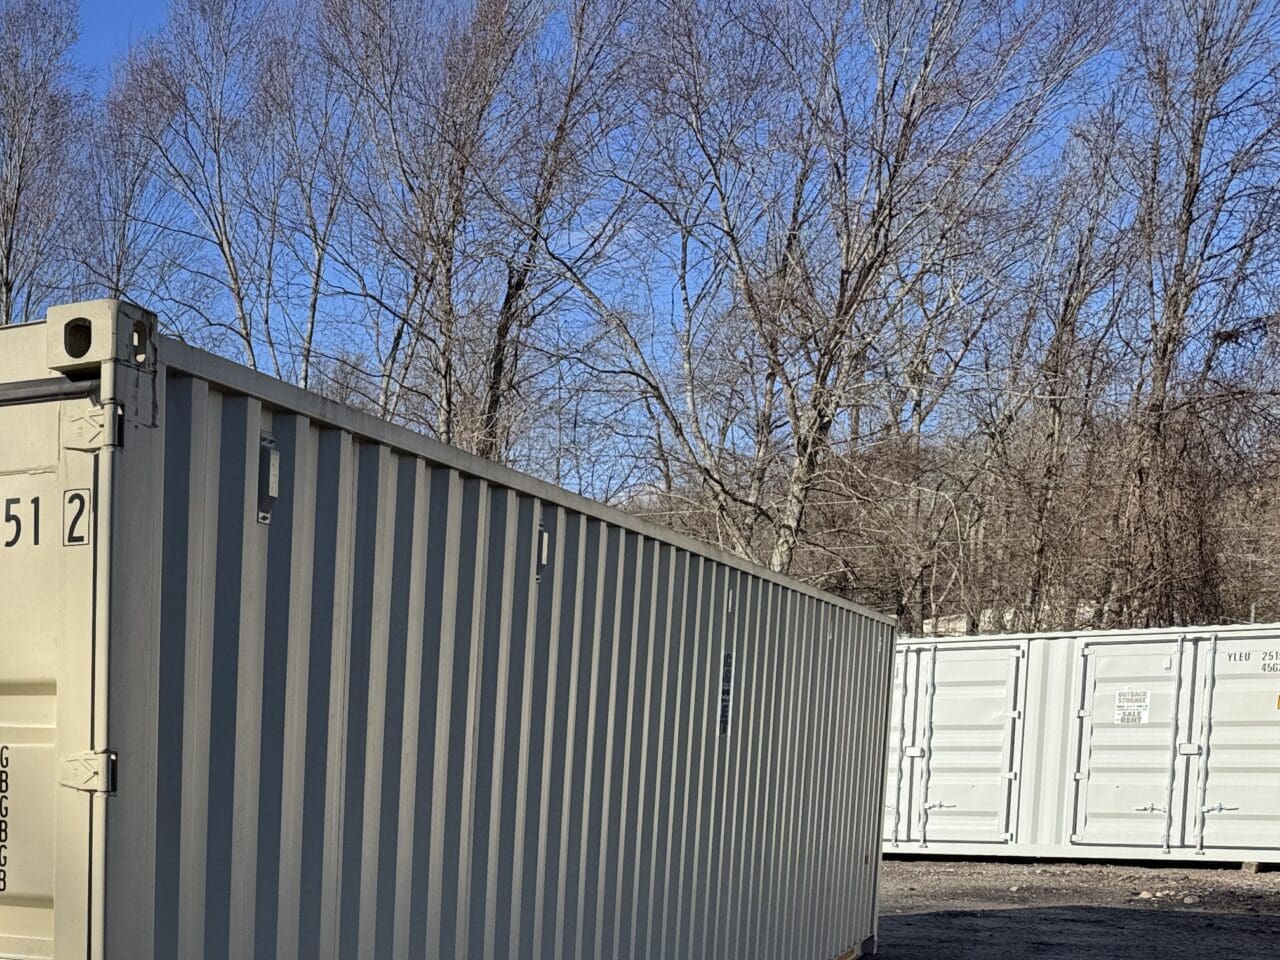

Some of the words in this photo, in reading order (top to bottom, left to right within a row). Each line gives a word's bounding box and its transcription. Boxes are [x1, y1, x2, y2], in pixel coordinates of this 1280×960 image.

[67, 492, 86, 543] 2
[1227, 651, 1251, 662] YLEU
[1261, 651, 1280, 661] 251
[1261, 662, 1280, 673] 45G
